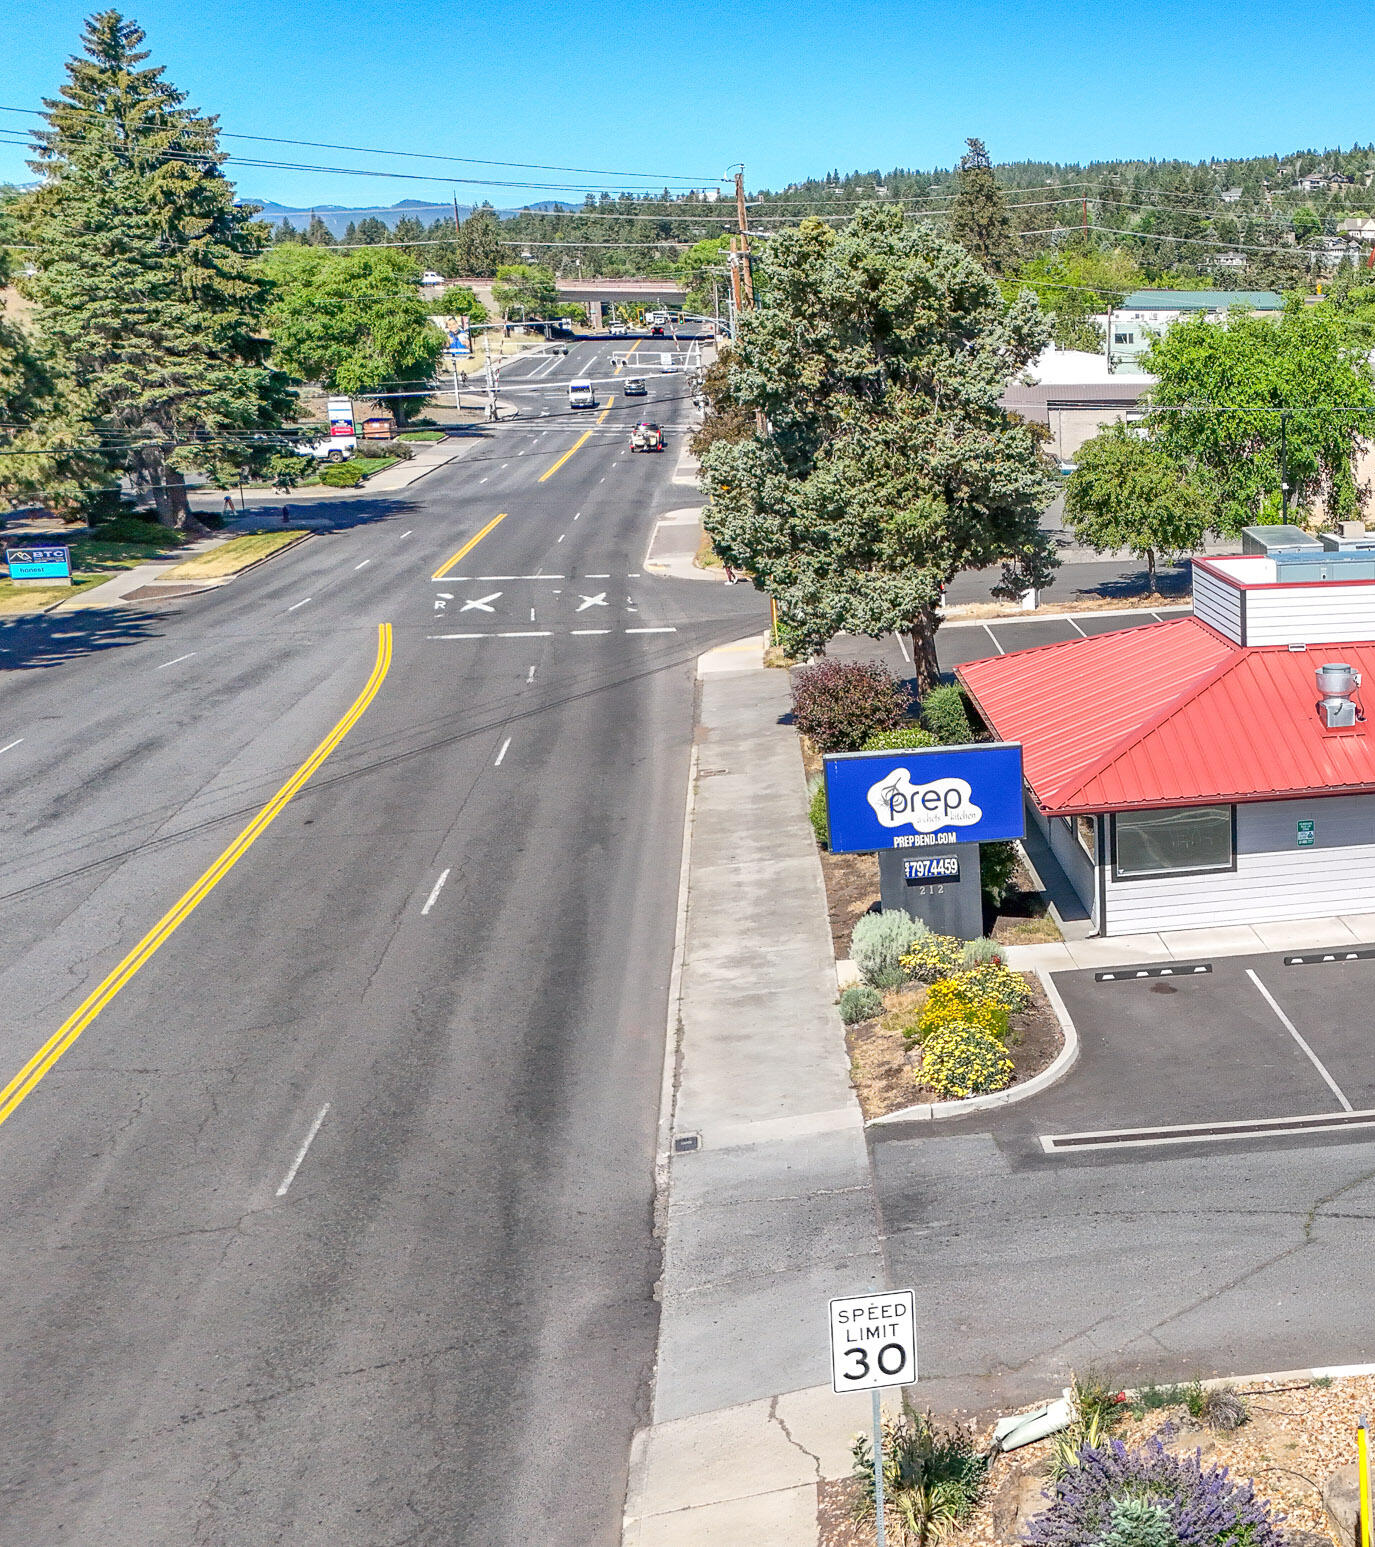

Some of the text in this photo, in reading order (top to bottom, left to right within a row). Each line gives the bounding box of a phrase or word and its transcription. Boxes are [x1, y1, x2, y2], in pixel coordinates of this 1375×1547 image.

[889, 788, 962, 821] prep
[893, 831, 957, 848] PREPBEND.COM
[838, 1303, 907, 1324] SPEED
[846, 1323, 900, 1342] LIMIT
[843, 1342, 907, 1381] 30
